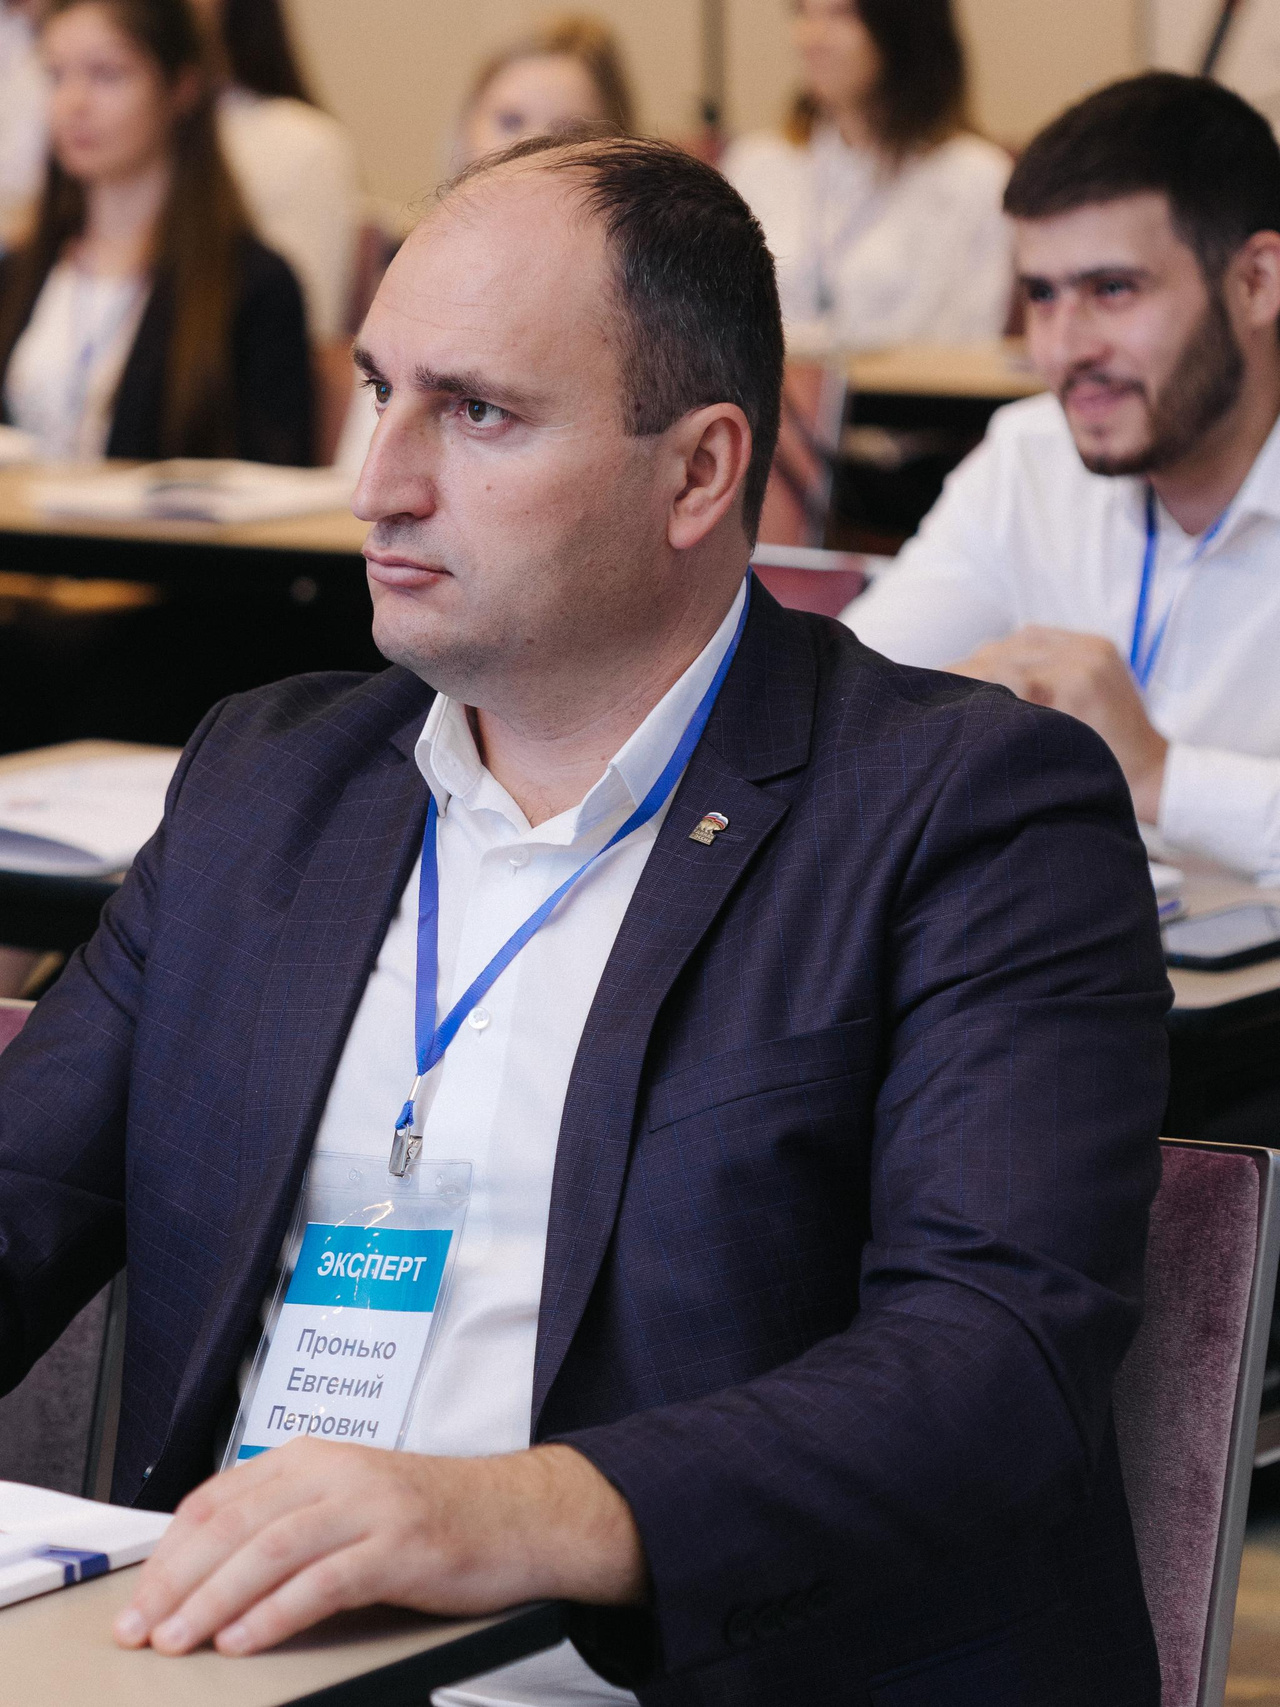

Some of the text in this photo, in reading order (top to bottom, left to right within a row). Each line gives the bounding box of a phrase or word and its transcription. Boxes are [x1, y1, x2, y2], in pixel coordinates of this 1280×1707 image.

[316, 1251, 428, 1282] ЭКСПЕРТ
[296, 1328, 398, 1360] Пронько
[286, 1366, 385, 1400] Евгений
[266, 1404, 380, 1440] Петрович
